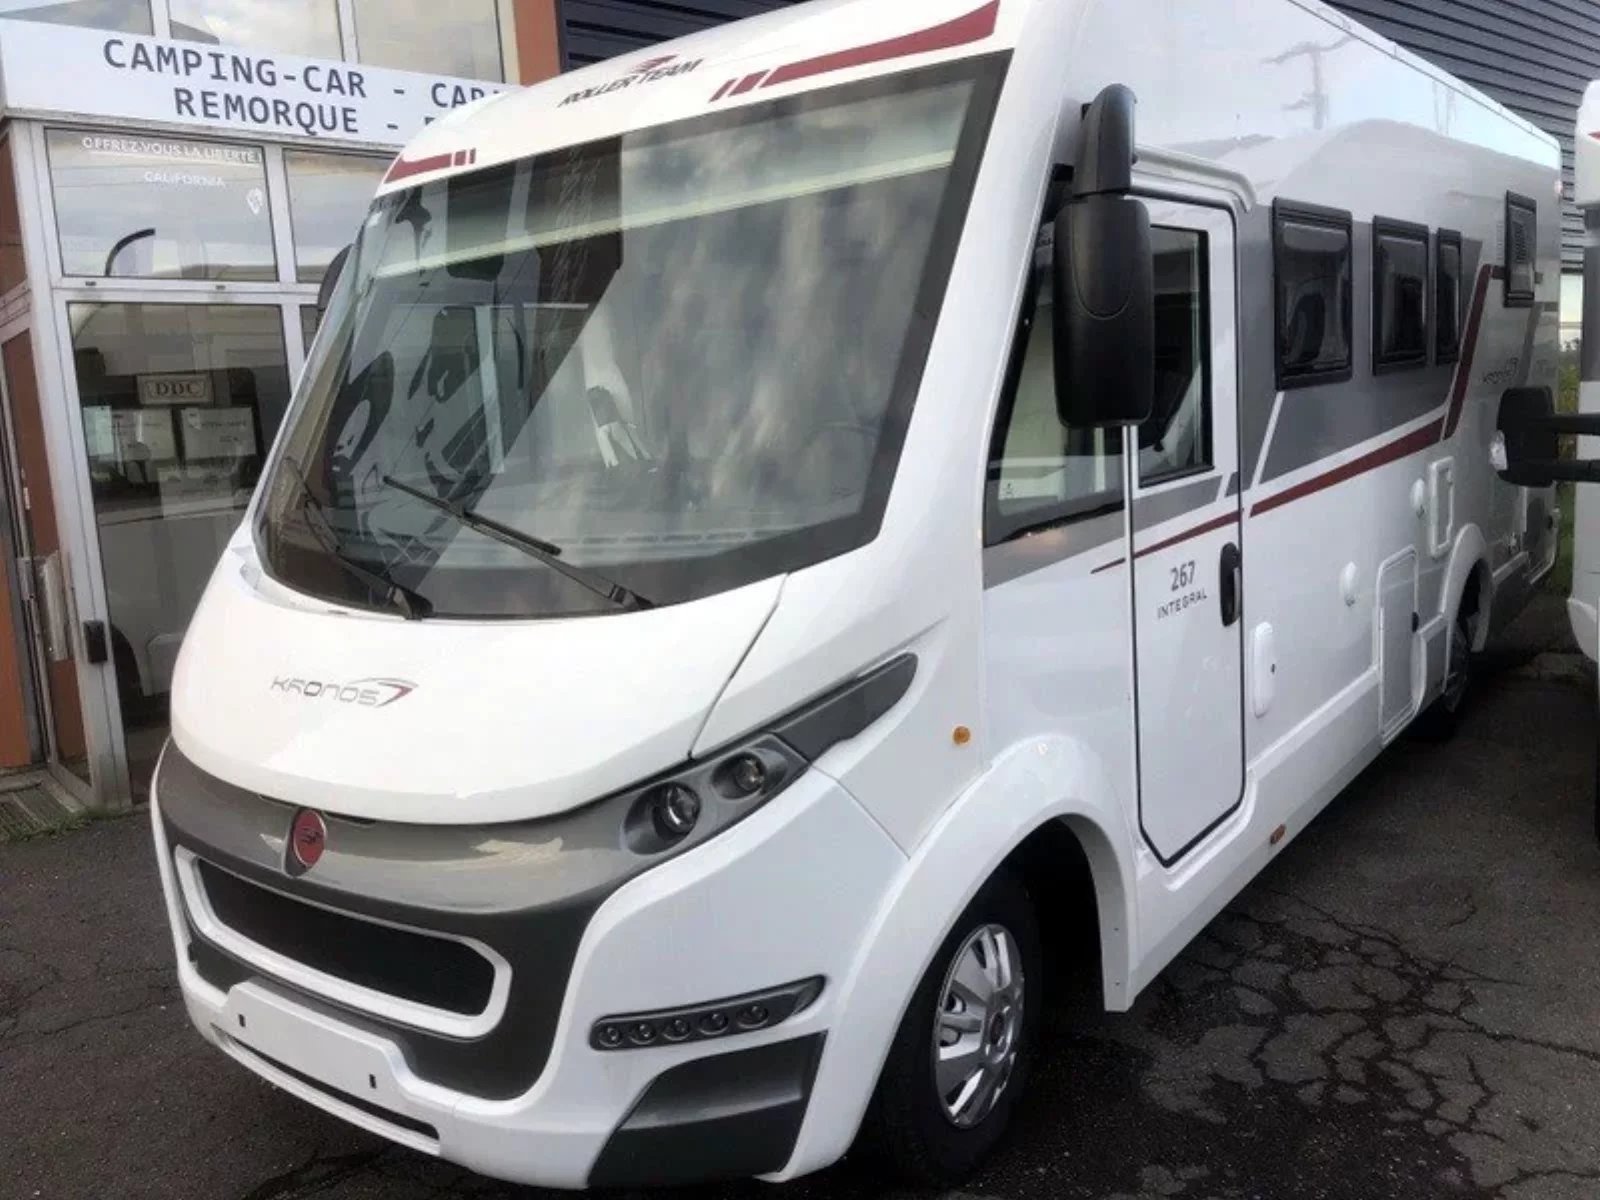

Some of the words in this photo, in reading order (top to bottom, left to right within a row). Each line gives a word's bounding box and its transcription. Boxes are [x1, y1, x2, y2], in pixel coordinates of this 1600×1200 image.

[103, 38, 367, 98] CAMPING-CAR
[174, 87, 359, 136] REMORQUE
[144, 170, 225, 188] CALIFORNIA
[155, 382, 201, 395] DDC
[1170, 560, 1195, 591] 267
[1157, 587, 1208, 618] INTEGRAL
[271, 677, 380, 706] KRONOS
